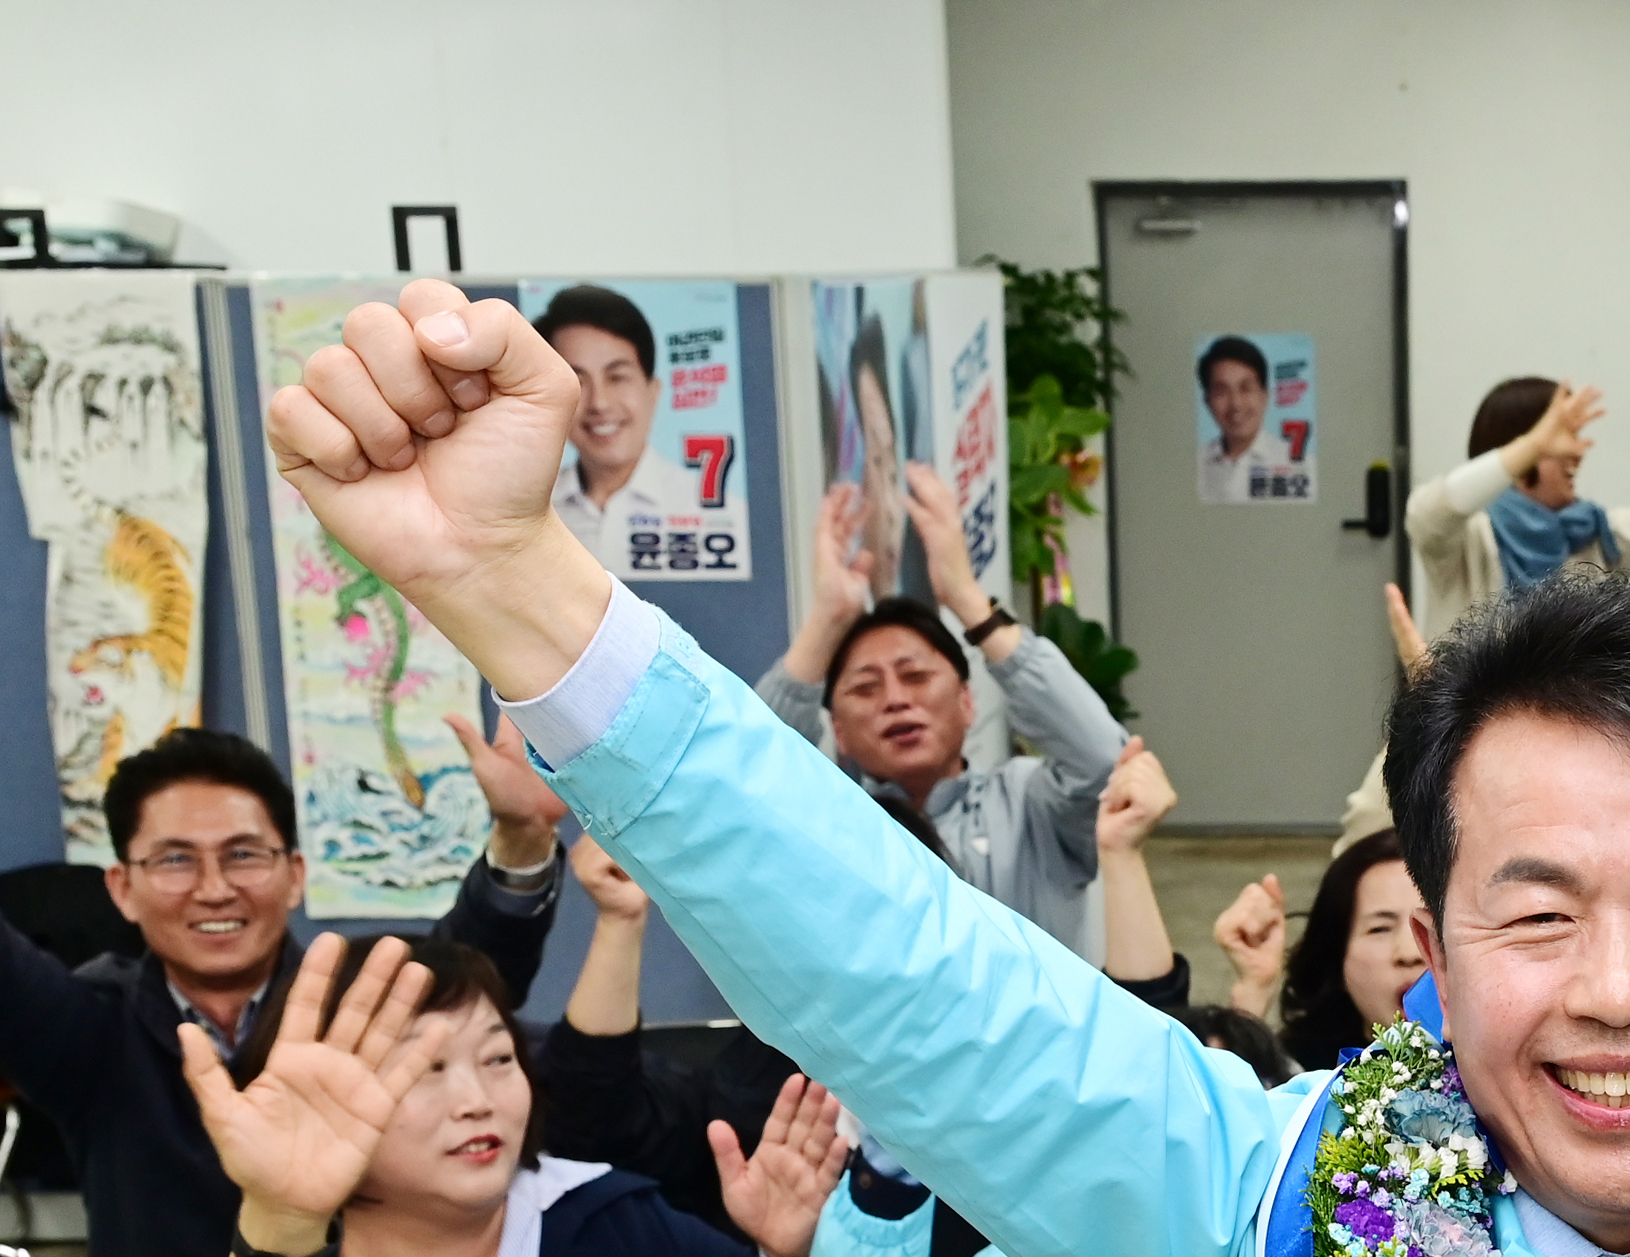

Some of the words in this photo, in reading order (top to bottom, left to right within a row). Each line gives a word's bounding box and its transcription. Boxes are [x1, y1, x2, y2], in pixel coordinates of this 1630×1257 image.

[1282, 420, 1309, 462] 7
[684, 435, 735, 508] 7
[630, 532, 737, 570] 윤종오
